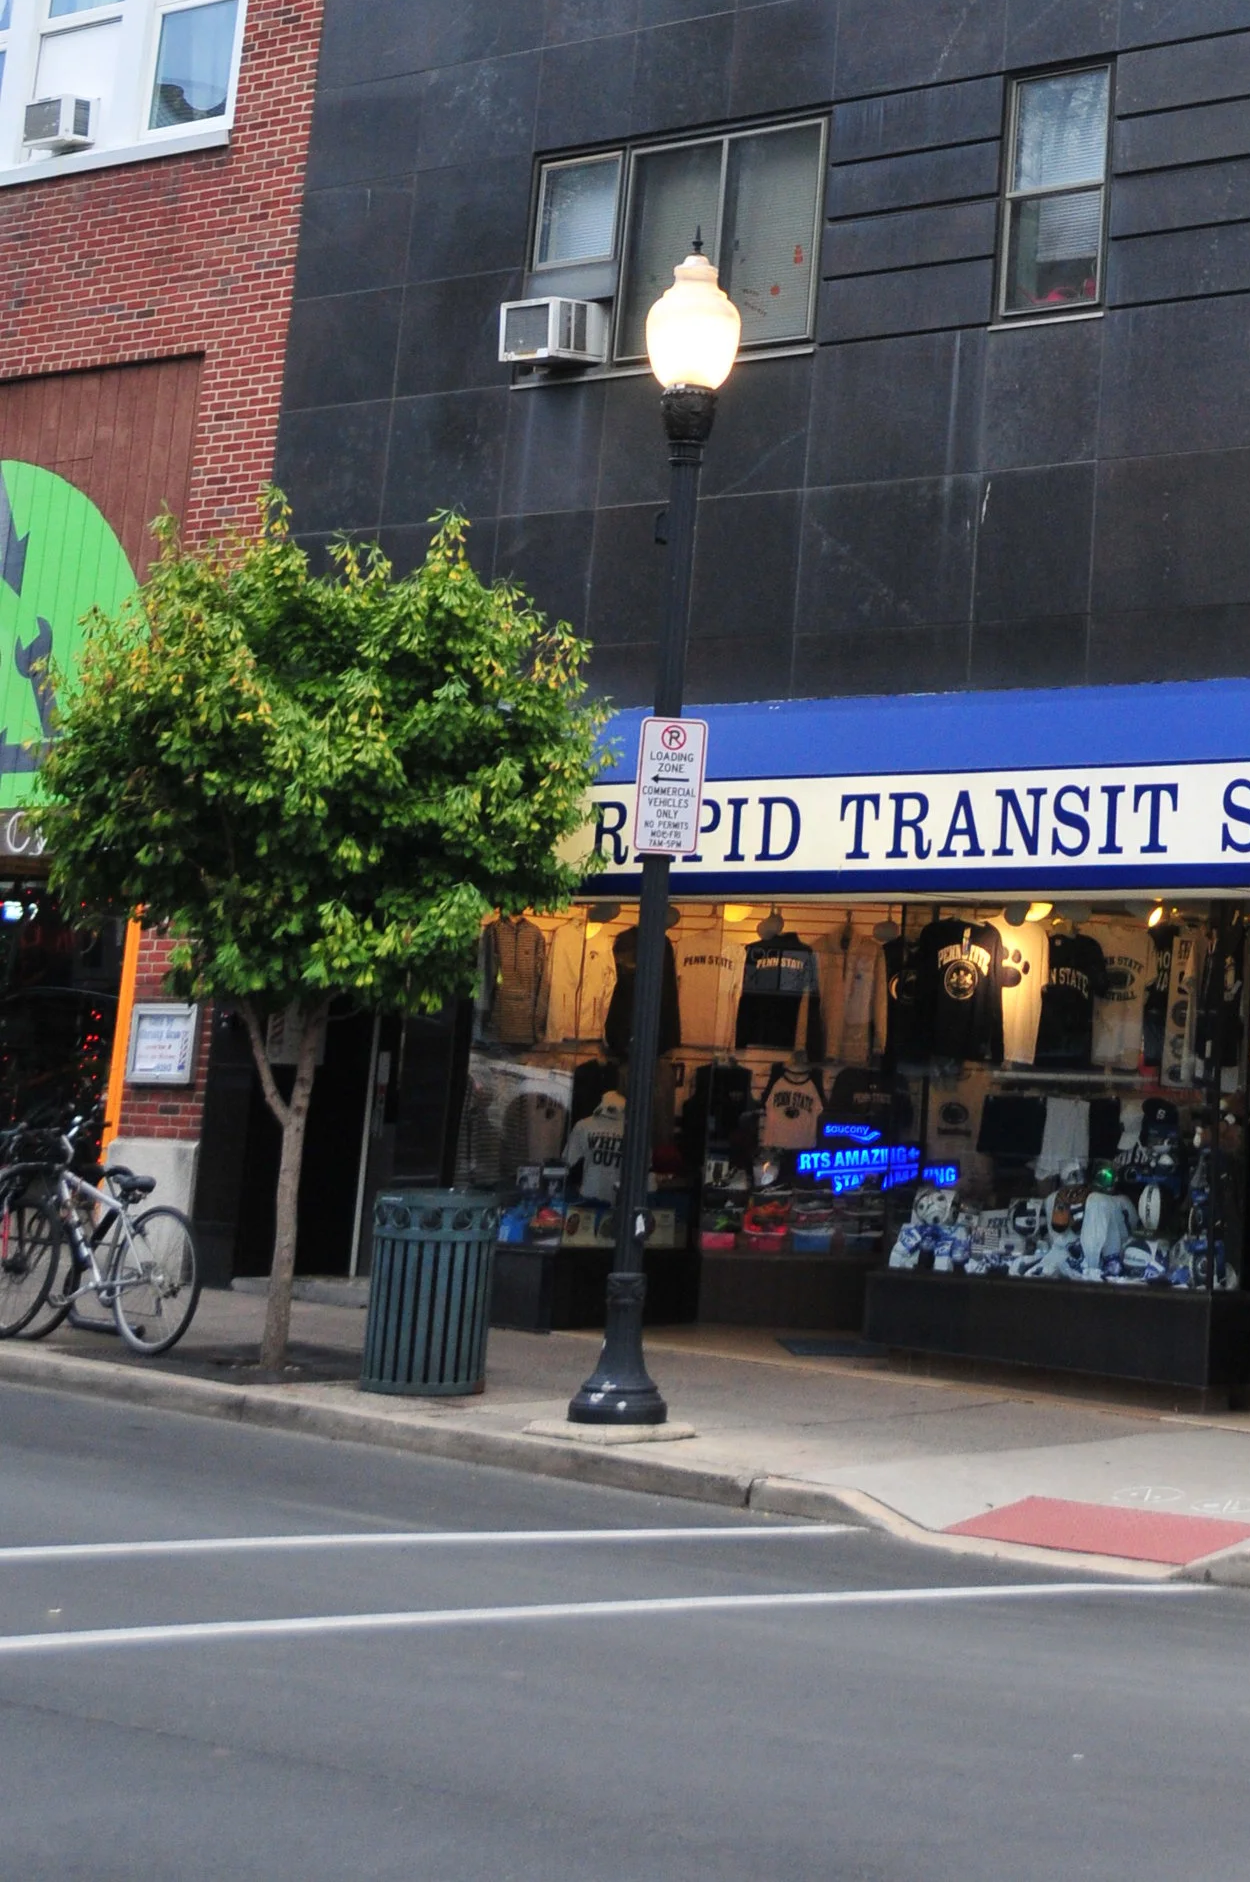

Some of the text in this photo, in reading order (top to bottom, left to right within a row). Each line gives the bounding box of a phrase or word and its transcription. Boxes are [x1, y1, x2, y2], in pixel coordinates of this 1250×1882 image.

[650, 751, 694, 763] LOADING
[657, 763, 685, 773] ZONE
[642, 785, 696, 798] COMMERCIAL
[648, 798, 689, 809] VEHICLES
[656, 809, 679, 819] ONLY
[591, 796, 801, 865] RPID
[840, 782, 1179, 861] TRANSIT
[644, 820, 689, 830] NO PERMITS
[649, 838, 682, 848] 7AM-5PM
[683, 956, 733, 970] PENN STATE
[756, 958, 779, 969] PENN
[825, 1123, 870, 1136] saucony
